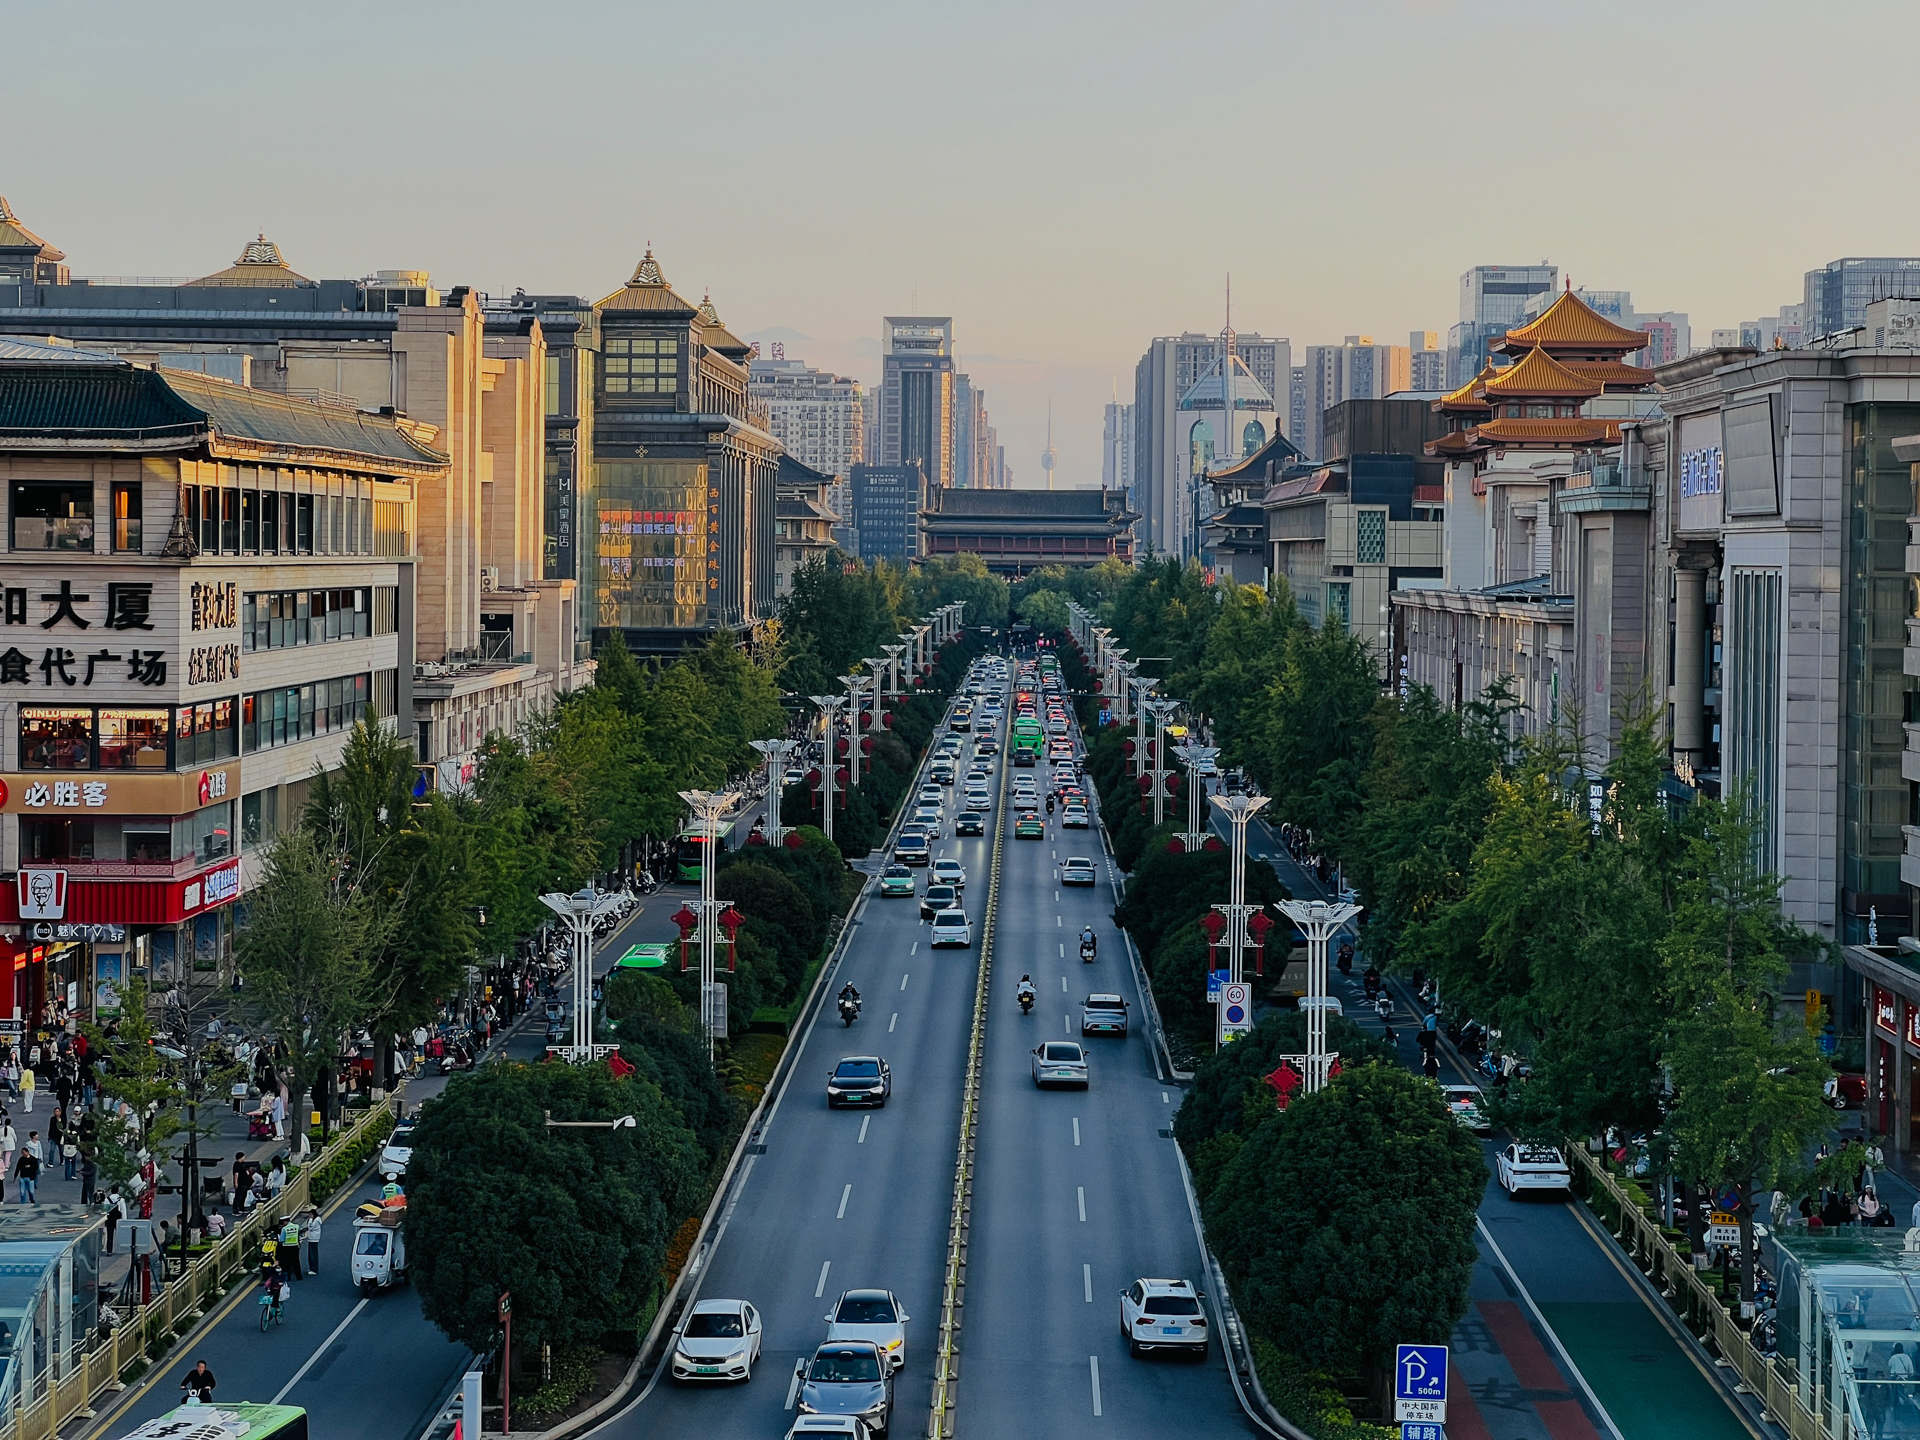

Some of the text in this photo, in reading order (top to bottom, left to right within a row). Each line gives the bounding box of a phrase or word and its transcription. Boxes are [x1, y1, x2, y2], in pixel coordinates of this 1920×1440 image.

[208, 770, 227, 799] 必胜客
[24, 781, 107, 807] 必胜客
[110, 933, 124, 942] 5F
[1229, 991, 1242, 999] 60
[1417, 1387, 1441, 1396] 500m
[1401, 1402, 1439, 1411] 中大国际
[1406, 1411, 1434, 1420] 停车场
[1407, 1426, 1437, 1440] 辅路
